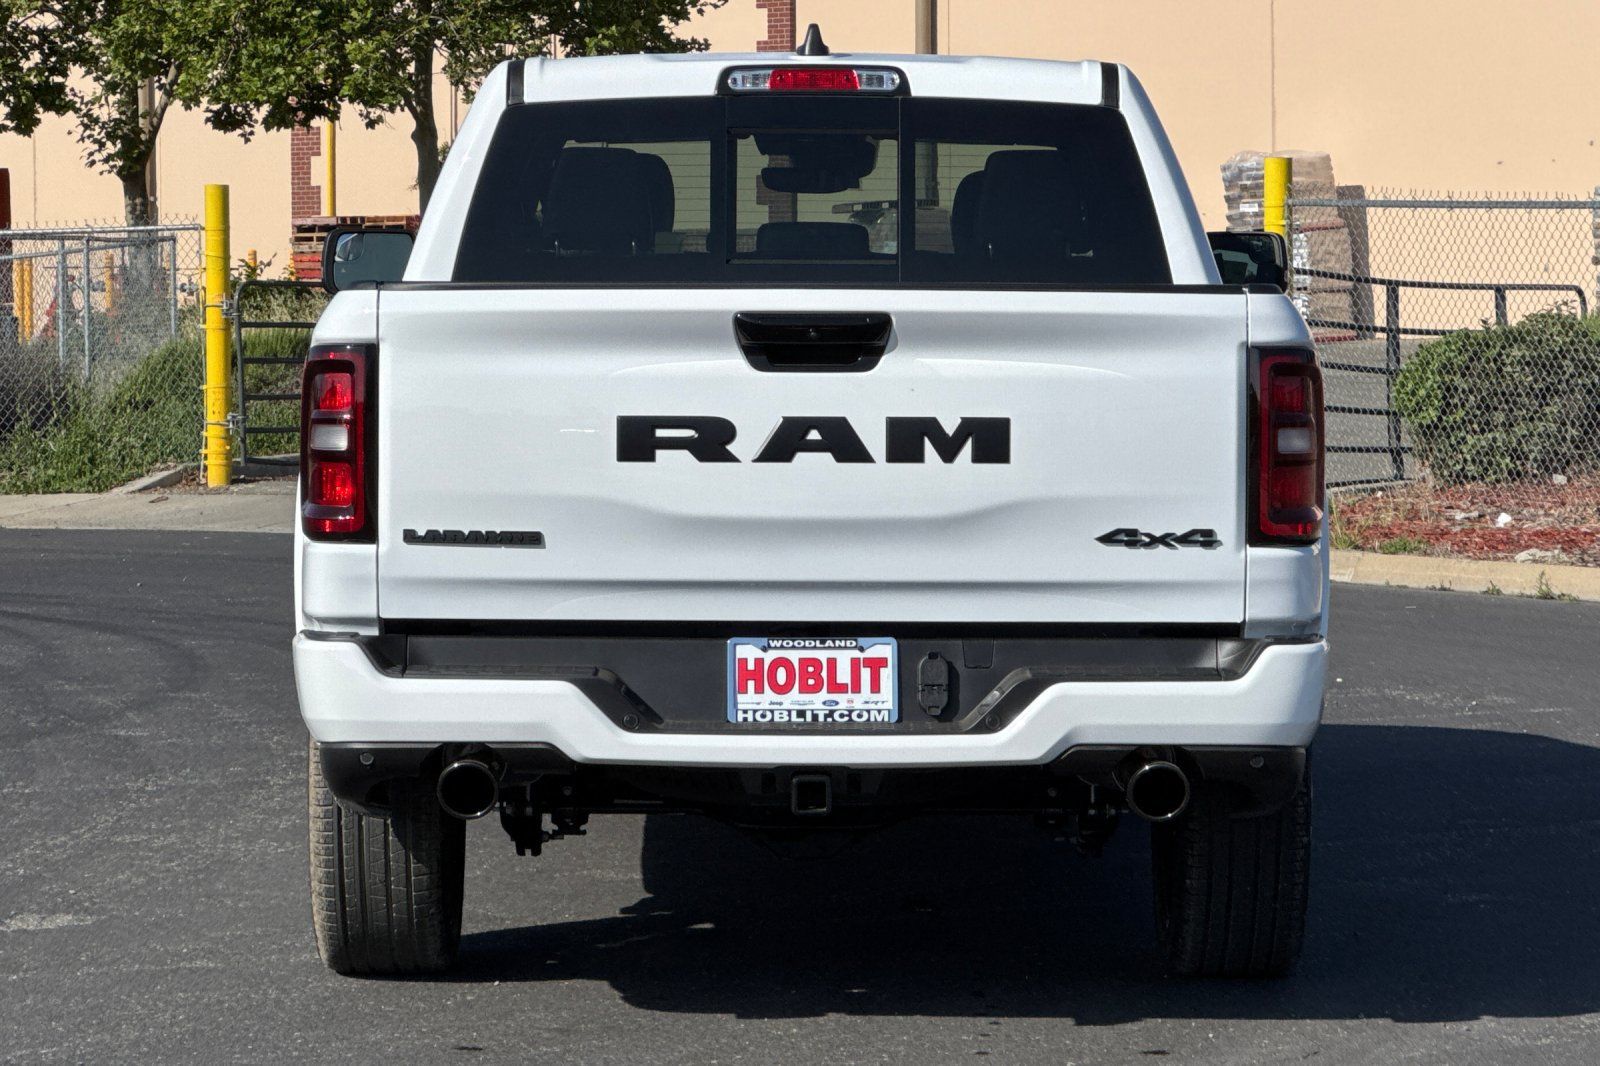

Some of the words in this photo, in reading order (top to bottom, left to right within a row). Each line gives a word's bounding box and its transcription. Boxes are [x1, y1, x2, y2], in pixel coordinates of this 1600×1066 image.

[616, 415, 1011, 464] RAM
[768, 639, 857, 648] WOODLAND
[737, 656, 888, 695] HOBLIT
[736, 709, 889, 722] HOBLIT.COM
